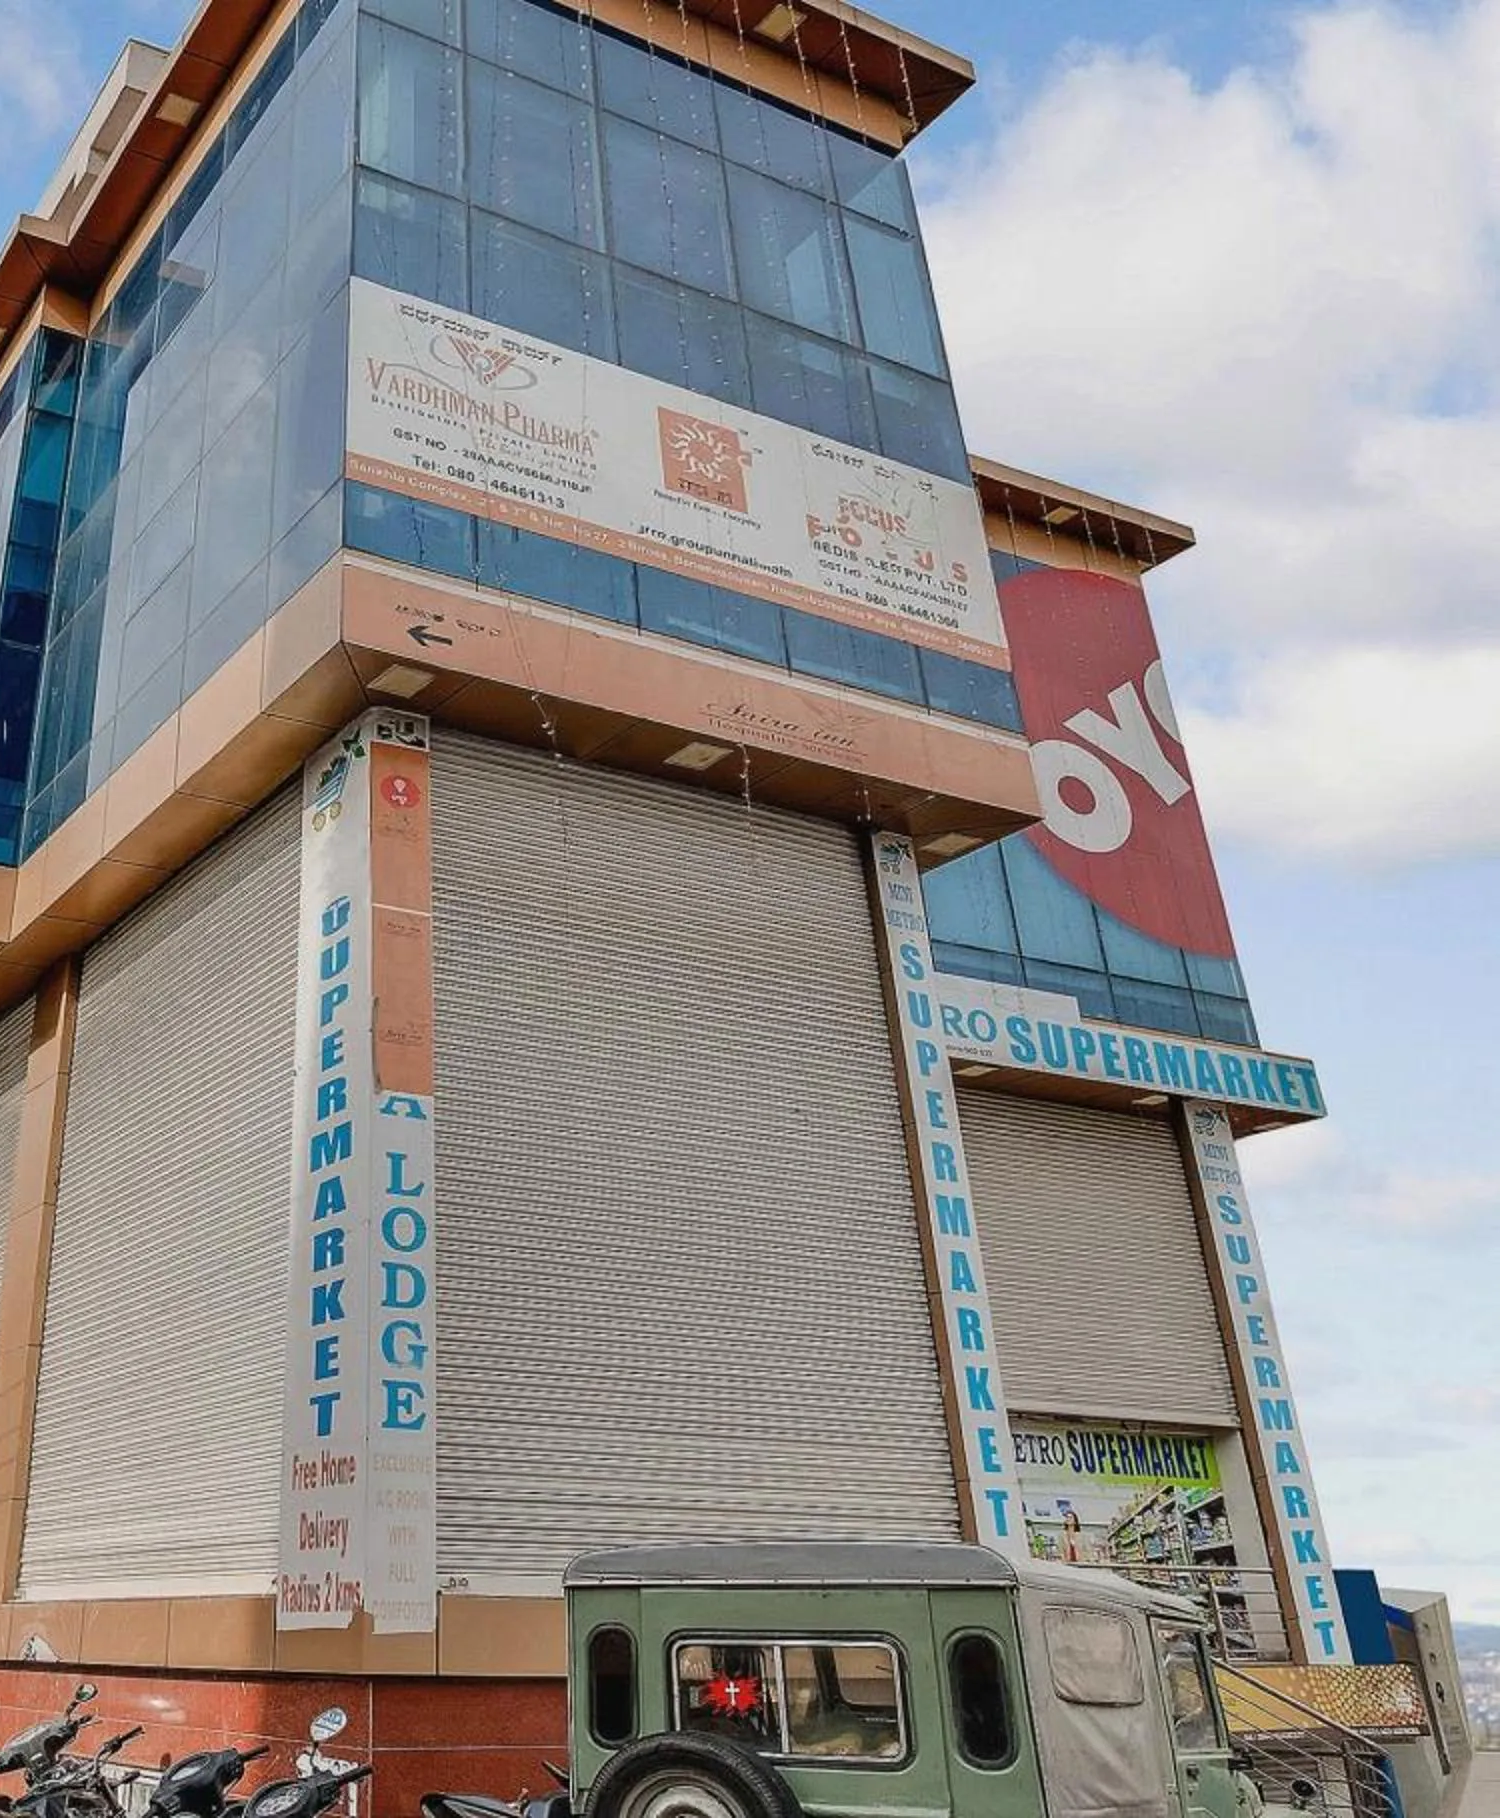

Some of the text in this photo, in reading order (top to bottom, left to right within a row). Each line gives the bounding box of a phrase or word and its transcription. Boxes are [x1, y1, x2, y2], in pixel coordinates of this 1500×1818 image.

[365, 357, 596, 457] VARDHMAN PHARMA
[393, 427, 422, 442] GST
[425, 436, 447, 451] NO
[413, 454, 442, 475] Tel:
[447, 465, 476, 483] 080
[939, 1003, 1325, 1111] RO SUPERMARKET
[900, 942, 1010, 1537] SUPERMARKET
[381, 1152, 429, 1432] LODGE
[1217, 1195, 1335, 1657] SUPERMARKET
[292, 1450, 356, 1491] Free Home
[1013, 1430, 1209, 1480] ETRO SUPERMARKET
[299, 1510, 349, 1558] Delivery
[281, 1574, 321, 1613] Radius
[324, 1572, 332, 1612] 2
